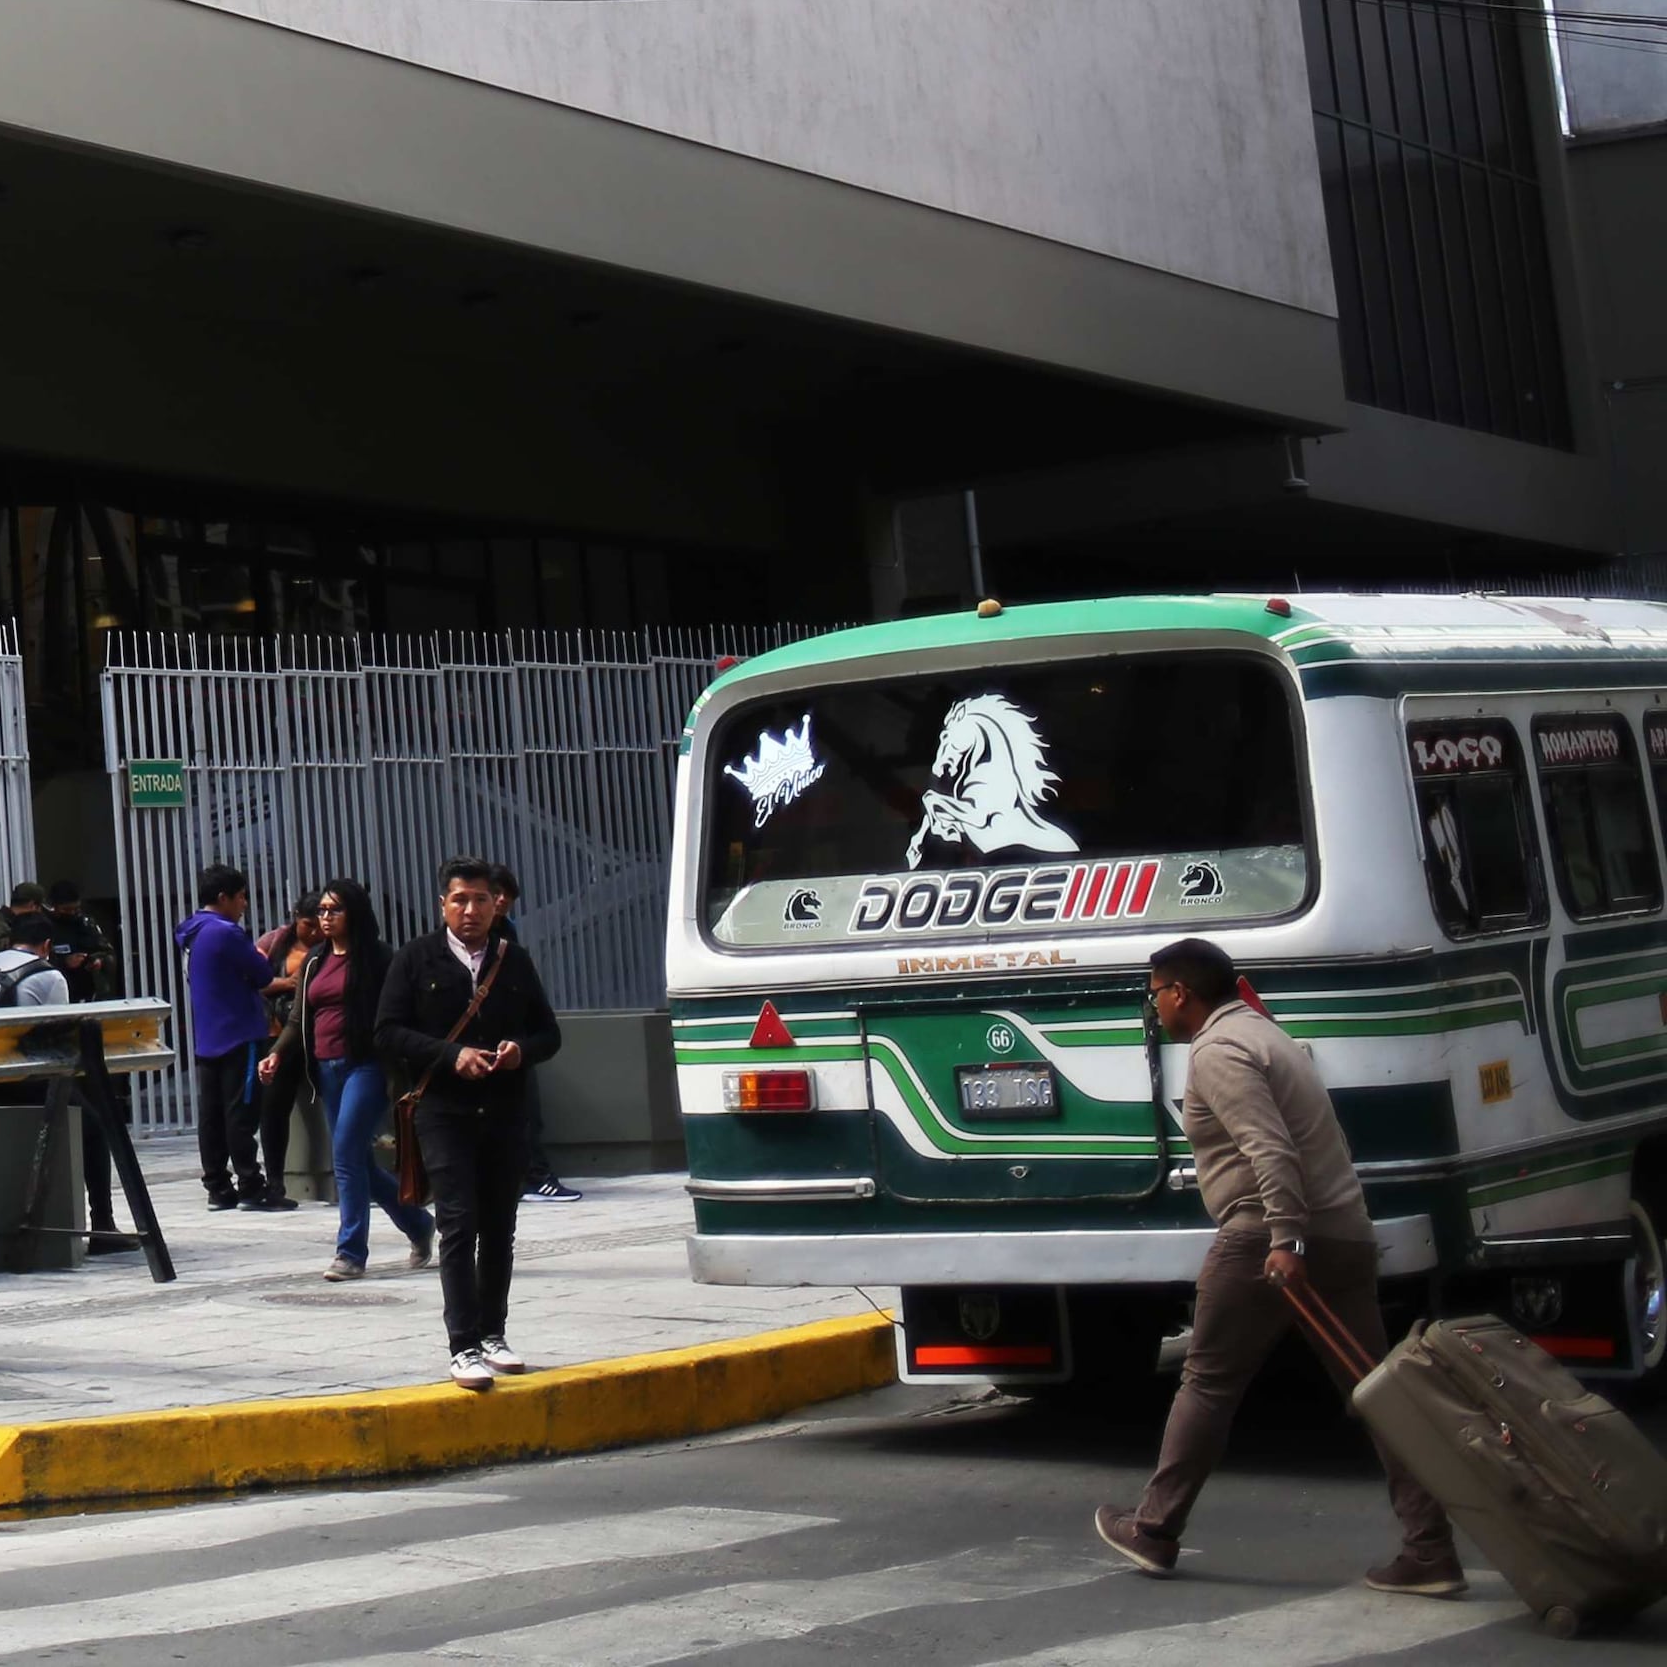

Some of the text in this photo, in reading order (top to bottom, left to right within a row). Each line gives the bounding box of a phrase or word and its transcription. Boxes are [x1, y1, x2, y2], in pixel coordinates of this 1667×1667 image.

[1412, 735, 1503, 771] LOCO
[1538, 728, 1620, 763] ROMANTICO
[131, 772, 183, 793] ENTRADA
[851, 869, 1070, 933] DODGE
[1180, 896, 1222, 905] BRONCO
[896, 948, 1077, 975] INMETAL
[991, 1029, 1010, 1048] 66
[962, 1079, 999, 1109] 133
